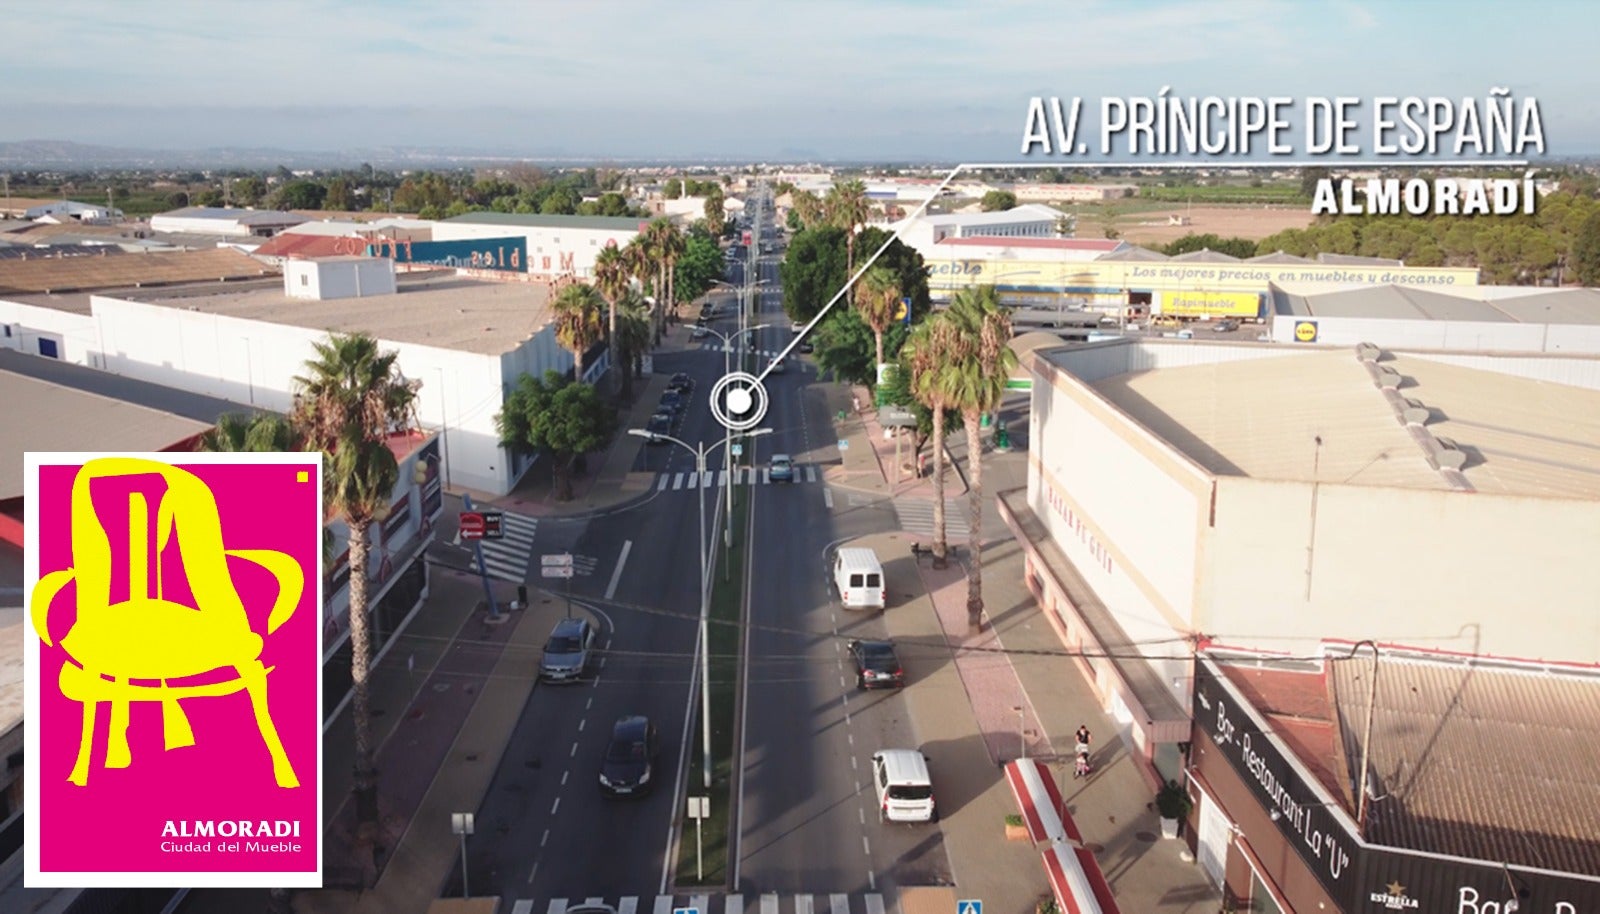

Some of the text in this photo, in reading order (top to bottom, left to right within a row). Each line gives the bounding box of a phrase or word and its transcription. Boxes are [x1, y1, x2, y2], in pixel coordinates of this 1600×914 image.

[1132, 266, 1455, 285] Los mejores precios en muebles y descanso
[1216, 701, 1235, 743] Bar
[1242, 733, 1304, 834] Restaurant
[1305, 809, 1322, 858] La
